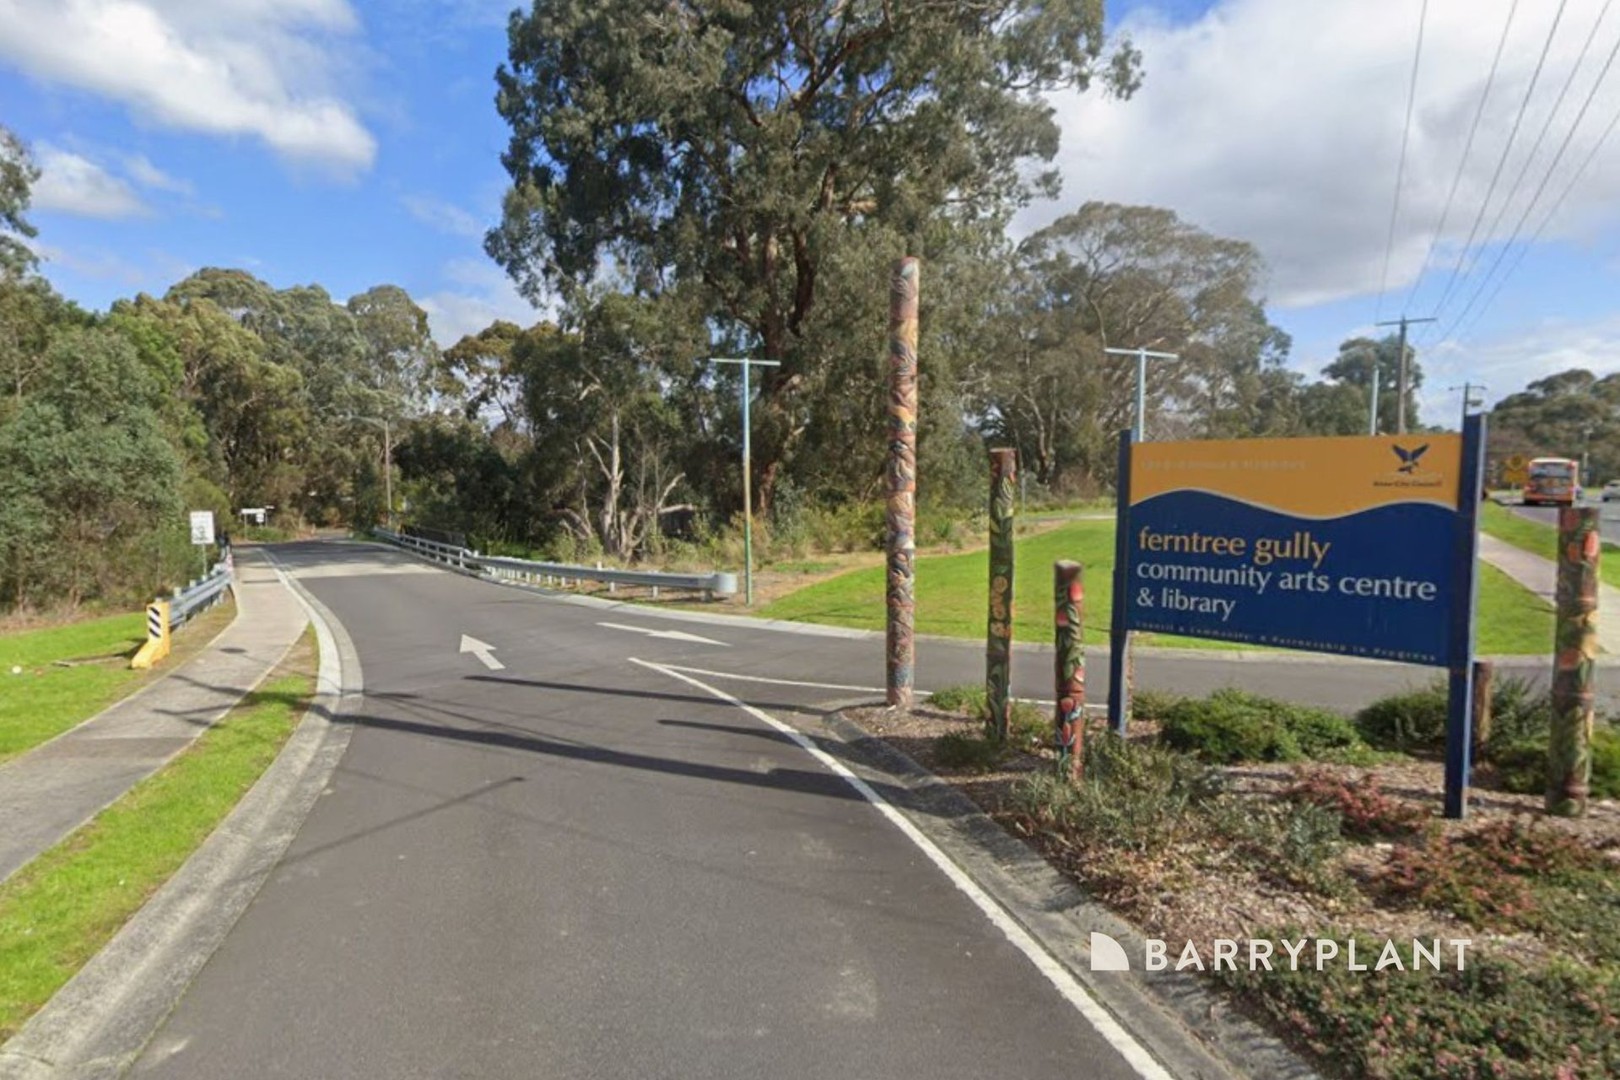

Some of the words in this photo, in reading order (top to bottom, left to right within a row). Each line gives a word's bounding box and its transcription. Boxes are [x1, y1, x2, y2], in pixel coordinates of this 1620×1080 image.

[1139, 525, 1246, 556] ferntree
[1254, 532, 1331, 569] gully
[1136, 561, 1272, 594] community
[1279, 571, 1330, 592] arts
[1338, 576, 1437, 601] centre
[1136, 587, 1154, 607] &
[1161, 587, 1235, 621] library
